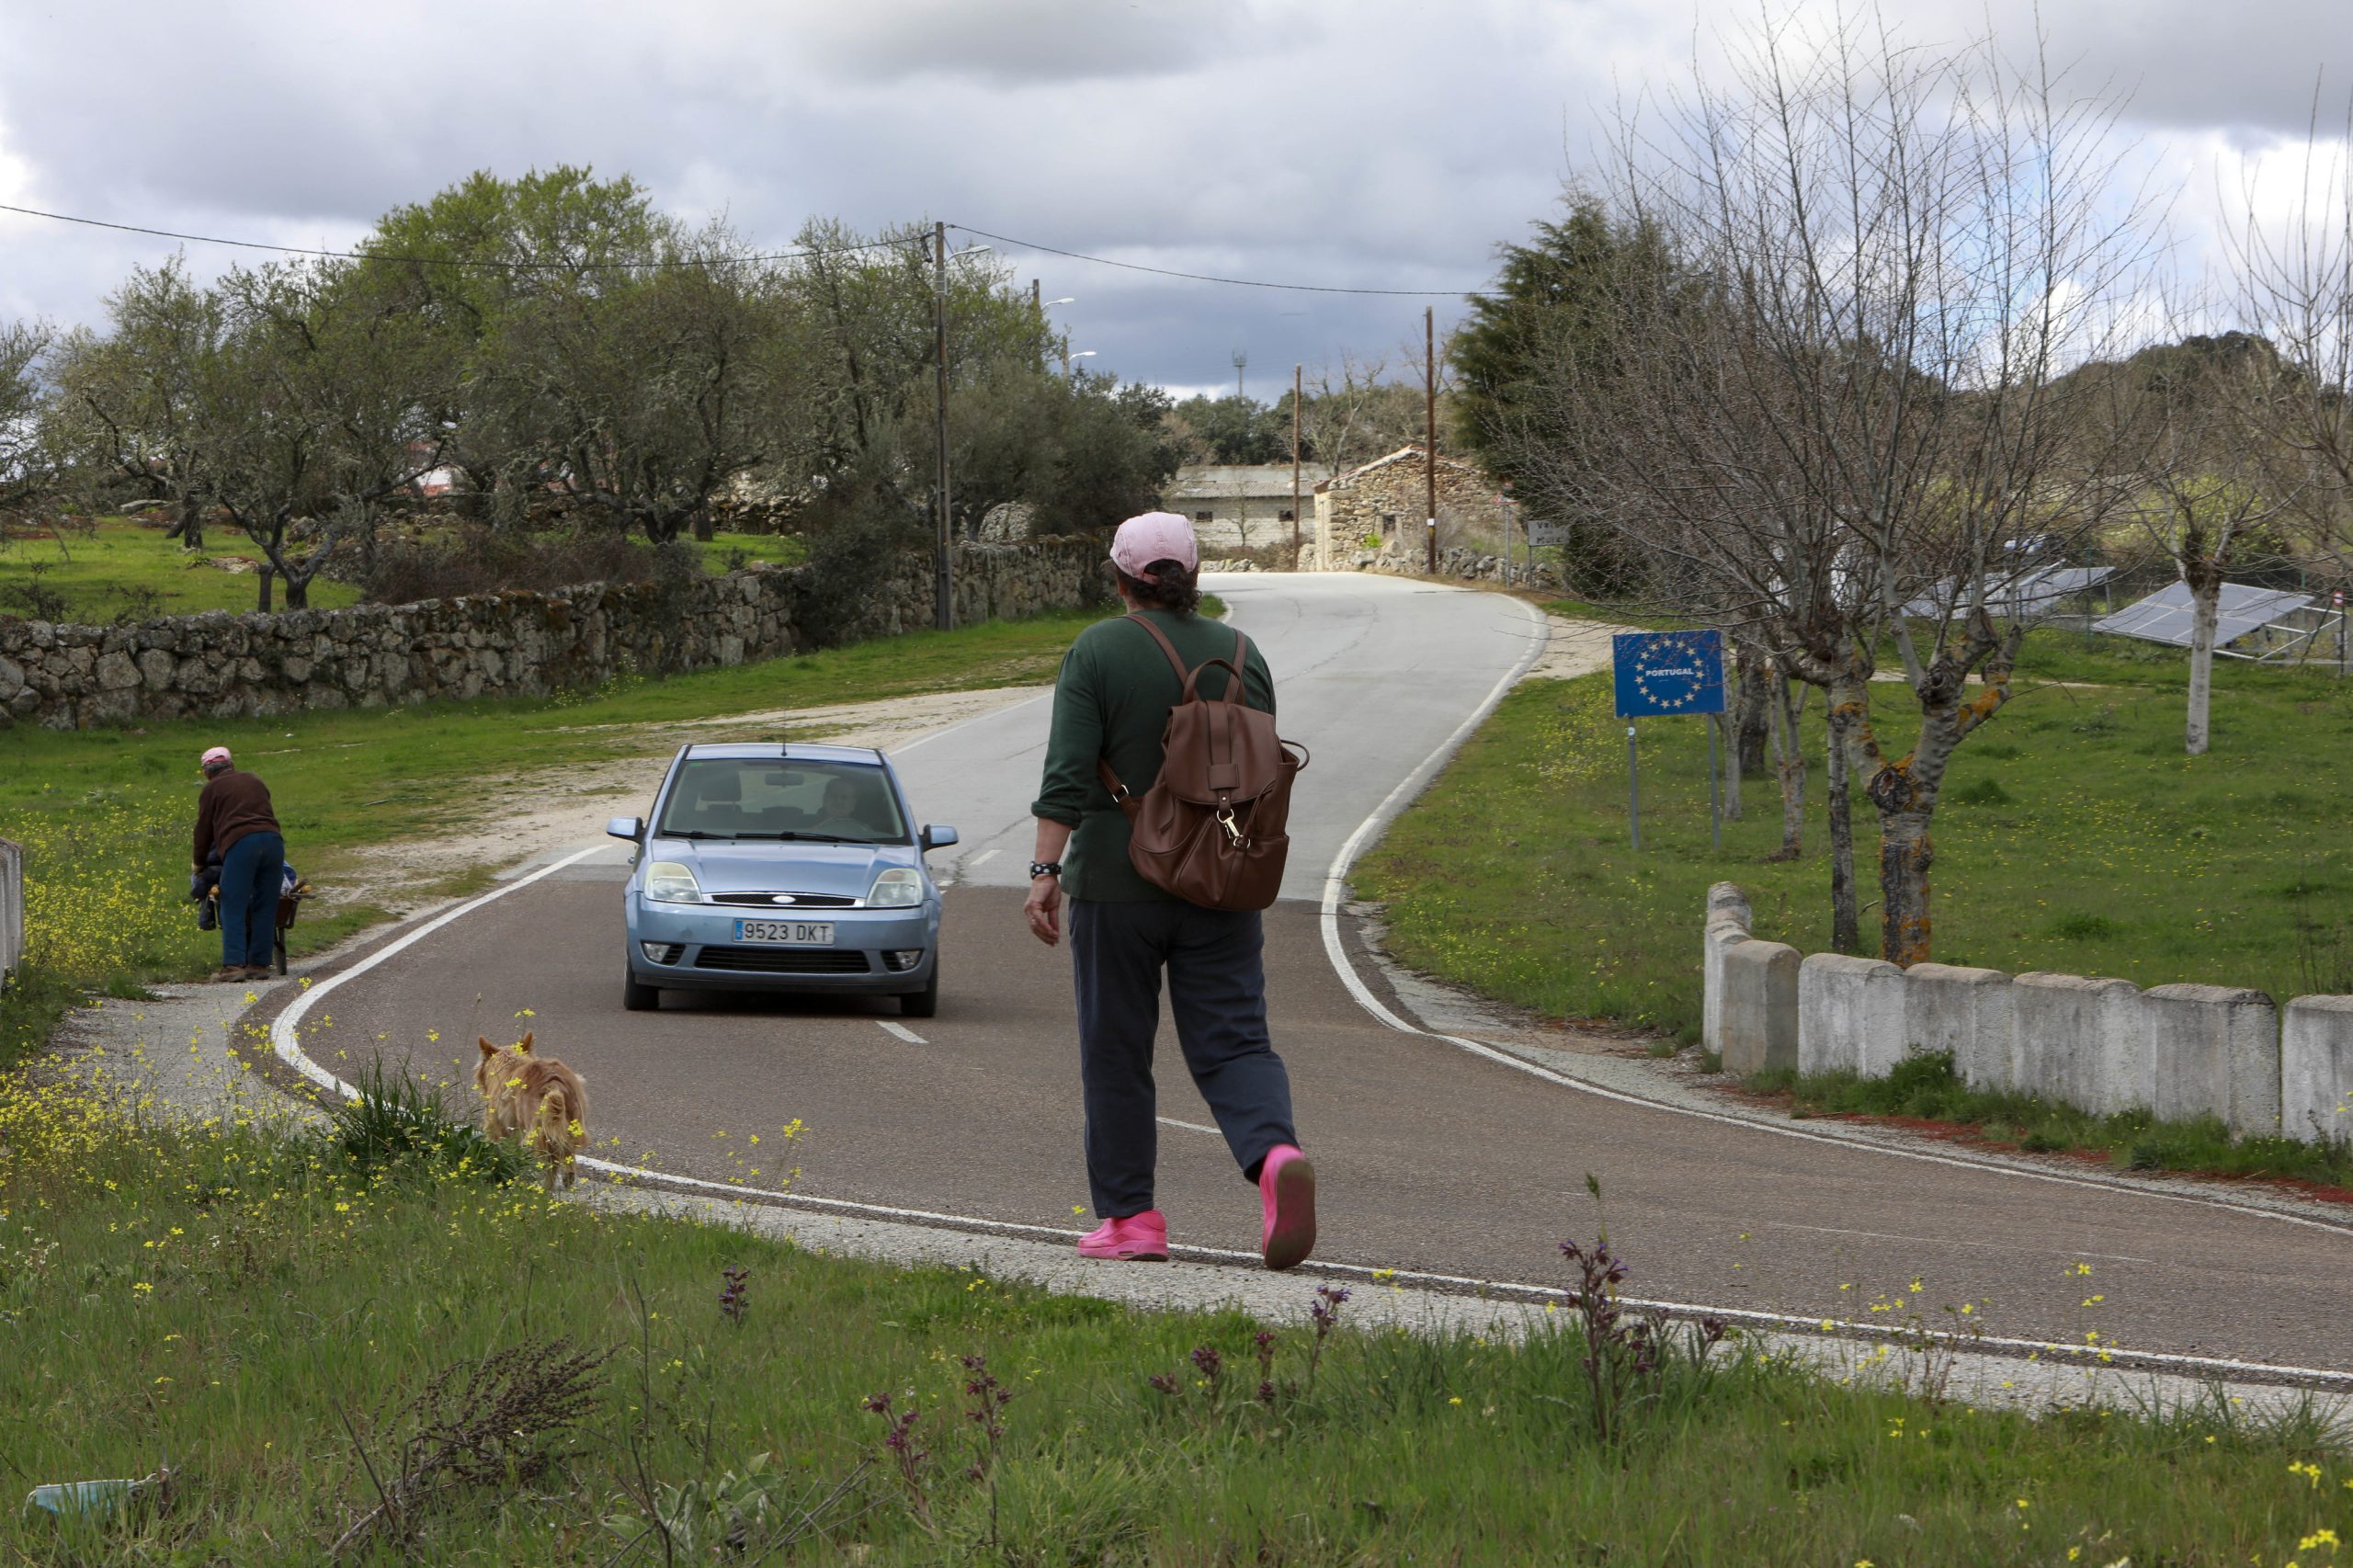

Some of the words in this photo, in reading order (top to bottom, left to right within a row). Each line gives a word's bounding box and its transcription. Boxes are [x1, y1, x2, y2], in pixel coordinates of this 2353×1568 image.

[1645, 668, 1694, 676] PORTUGAL
[745, 923, 789, 940] 9523
[796, 925, 829, 941] DKT
